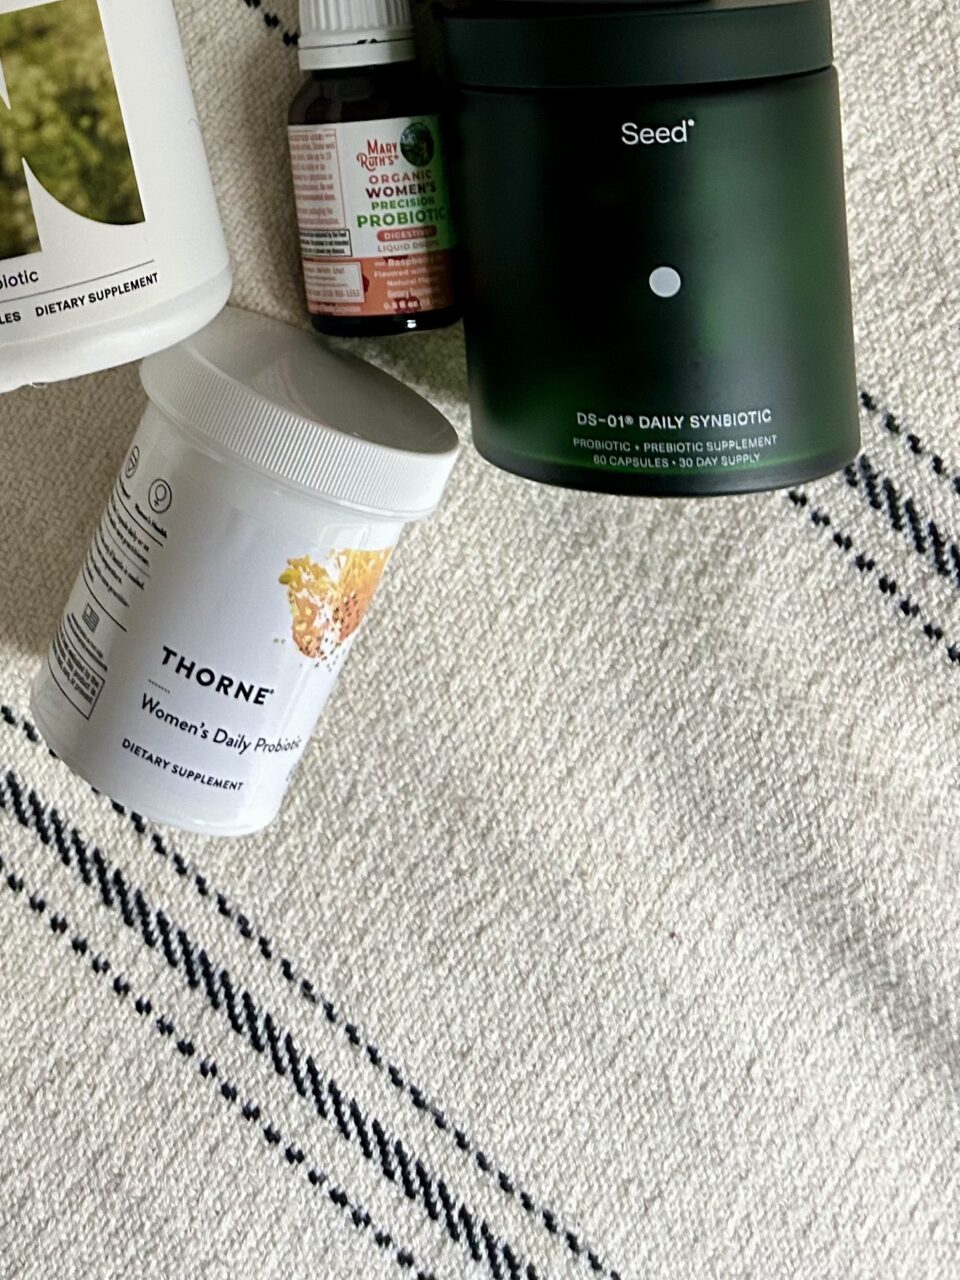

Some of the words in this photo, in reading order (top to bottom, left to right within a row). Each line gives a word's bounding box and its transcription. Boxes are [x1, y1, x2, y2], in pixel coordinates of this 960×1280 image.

[621, 120, 689, 145] Seed
[367, 139, 398, 156] MARY
[369, 170, 432, 185] ORGANIC
[365, 180, 436, 199] WOMEN'S
[371, 196, 435, 211] PRECISION
[357, 207, 445, 229] PROBIOTIC
[377, 242, 410, 253] LIQUID
[35, 296, 85, 317] DIETARY
[88, 273, 159, 304] SUPPLEMENT
[639, 415, 684, 429] DAILY
[690, 409, 772, 429] SYNBIOTIC
[573, 437, 630, 452] PROBIOTIC
[643, 442, 703, 453] PREBIOTIC
[706, 434, 778, 452] SUPPLEMENT
[593, 454, 606, 465] 60
[609, 456, 669, 468] CAPSULES
[678, 457, 693, 468] 30
[696, 456, 719, 468] DAY
[721, 453, 761, 466] SUPPLY
[161, 645, 274, 706] THORNE
[141, 692, 210, 740] Women's
[212, 728, 251, 755] Daily
[122, 737, 171, 770] DIETARY
[171, 764, 244, 791] SUPPLEMENT
